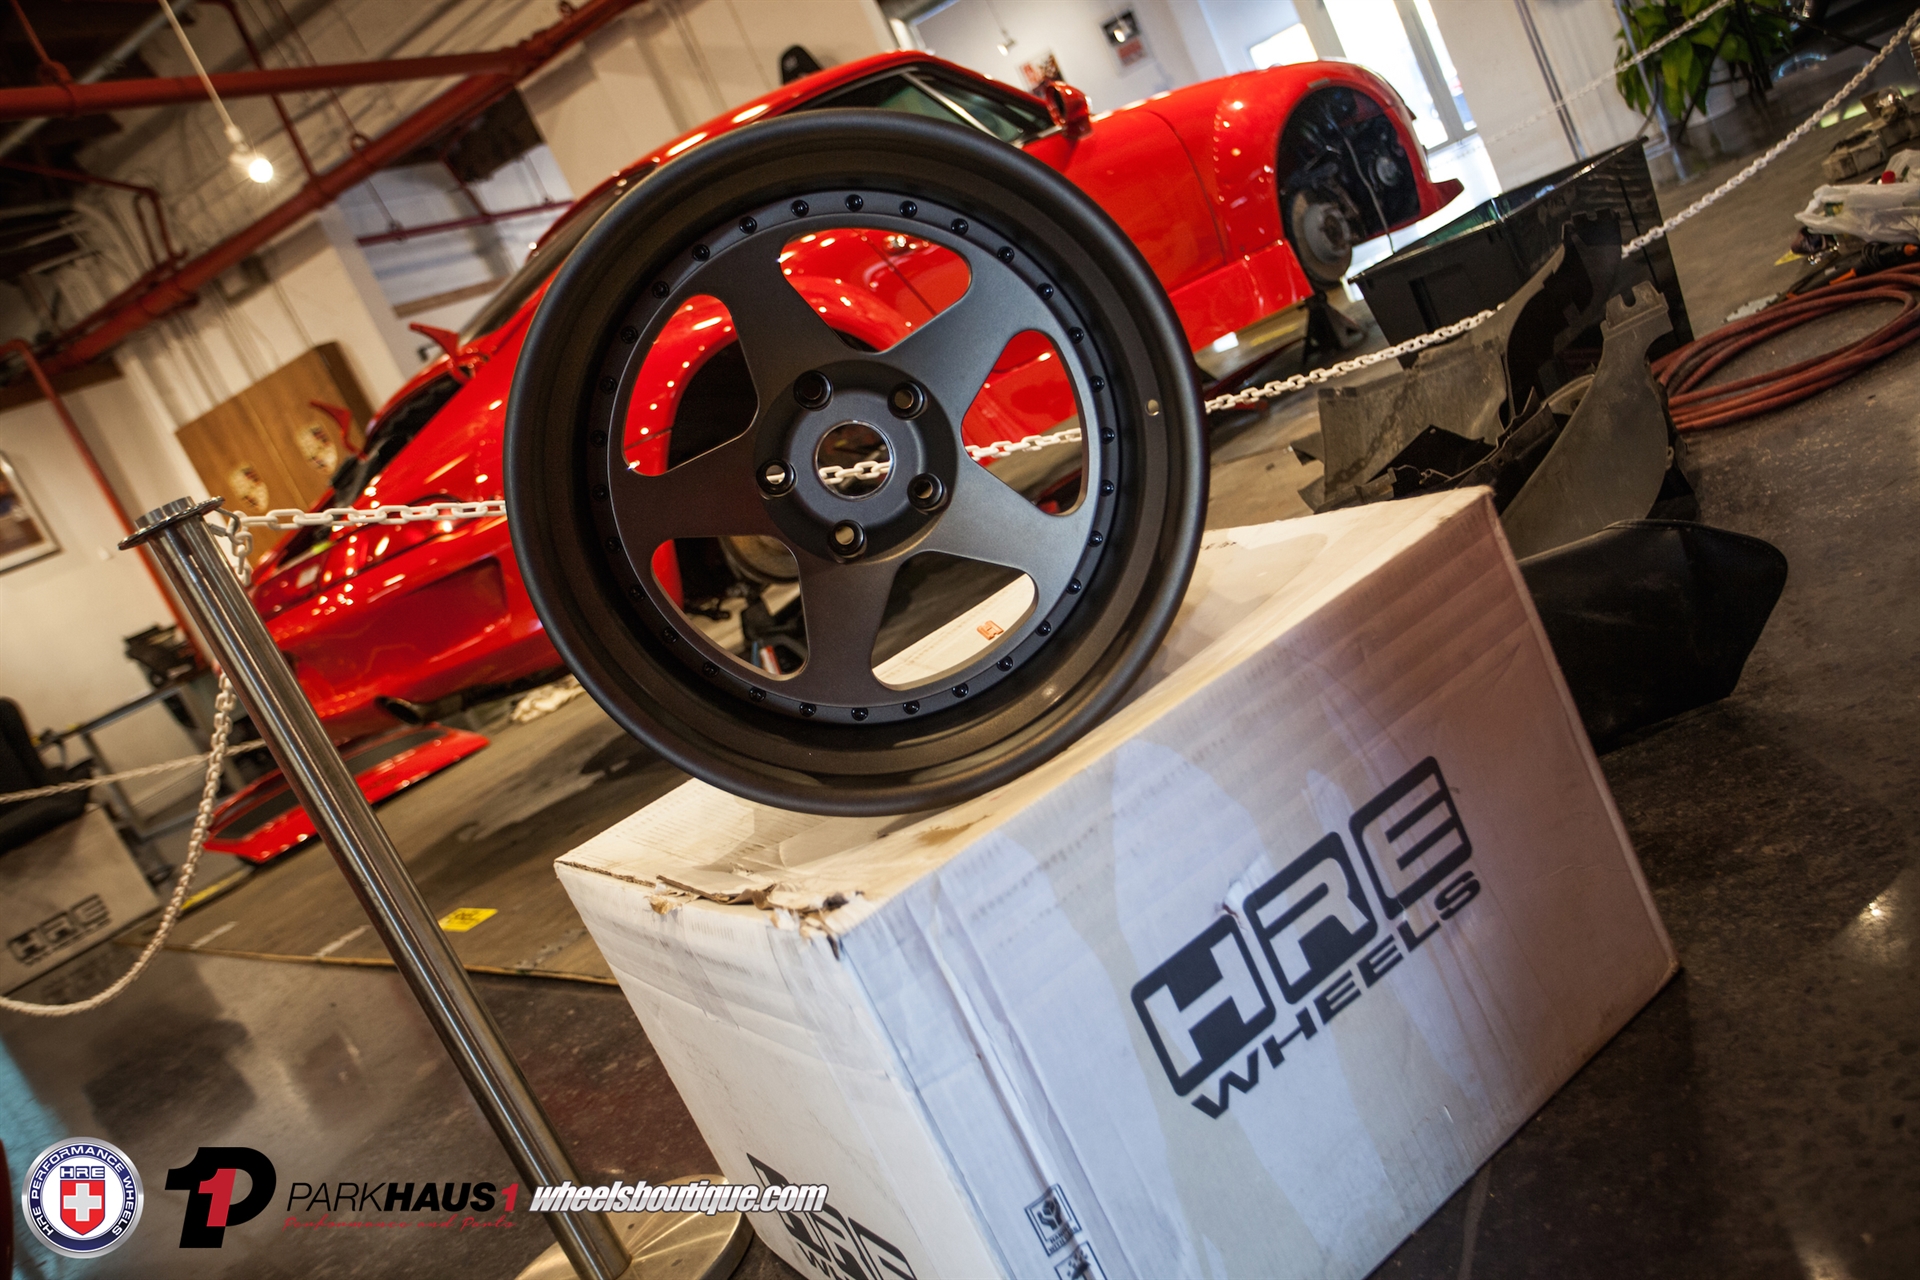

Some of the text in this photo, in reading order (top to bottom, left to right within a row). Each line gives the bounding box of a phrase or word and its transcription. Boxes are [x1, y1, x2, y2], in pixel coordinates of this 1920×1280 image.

[7, 893, 110, 964] HRE
[1131, 756, 1472, 1097] HRE
[1191, 870, 1481, 1120] WHEELS
